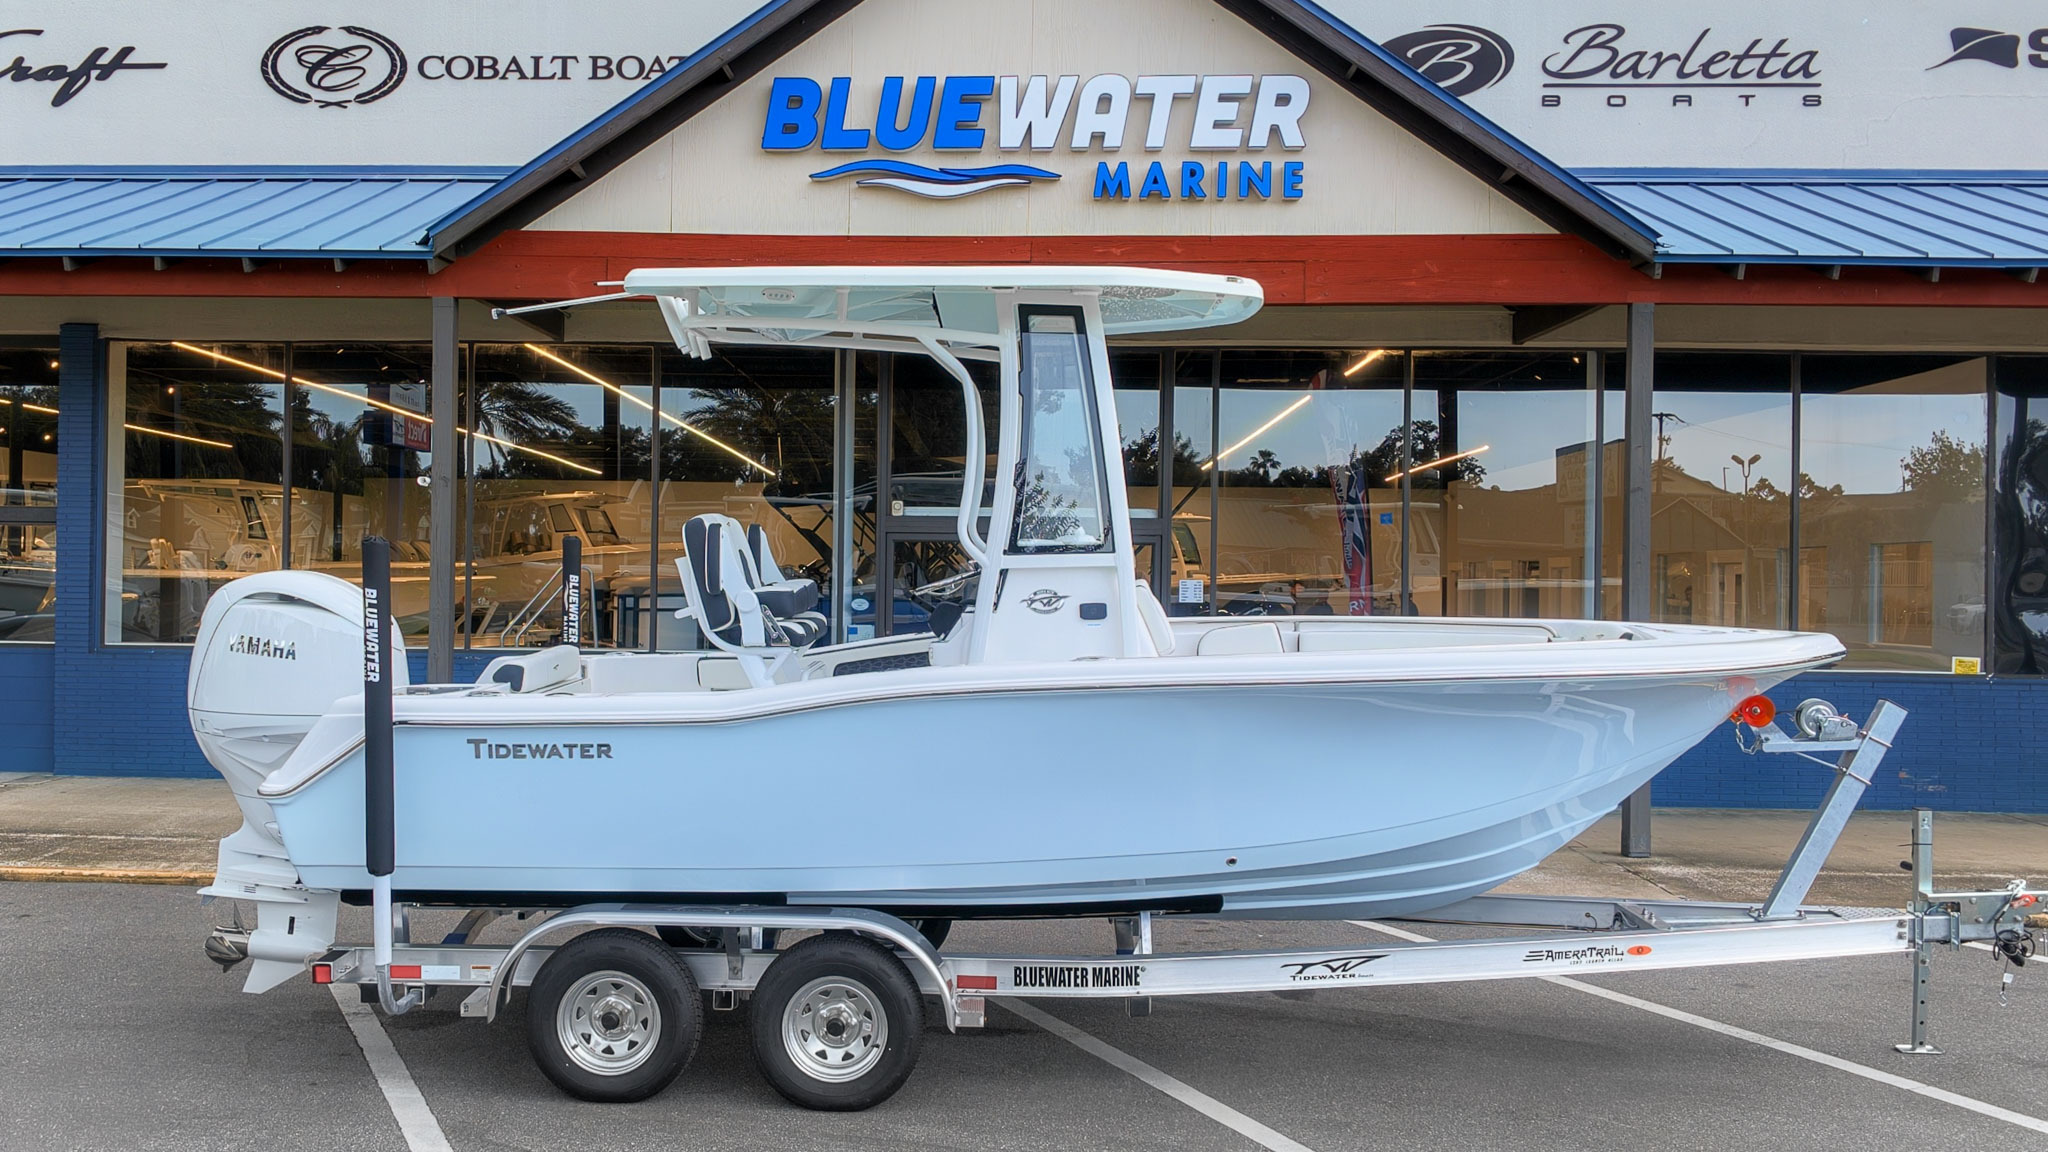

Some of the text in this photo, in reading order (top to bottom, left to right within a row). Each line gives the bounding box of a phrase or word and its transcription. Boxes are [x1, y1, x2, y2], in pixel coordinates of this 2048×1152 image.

[417, 55, 579, 80] COBALT
[1542, 23, 1822, 80] Barletta
[762, 74, 1311, 152] BLUEWATER
[1542, 95, 1822, 107] BOATS
[1093, 161, 1304, 201] MARINE
[565, 574, 580, 643] BLUEWATER
[229, 633, 296, 660] YAMAHA
[364, 588, 380, 683] BLUEWATER
[1013, 965, 1140, 988] BLUEWATER MARINE
